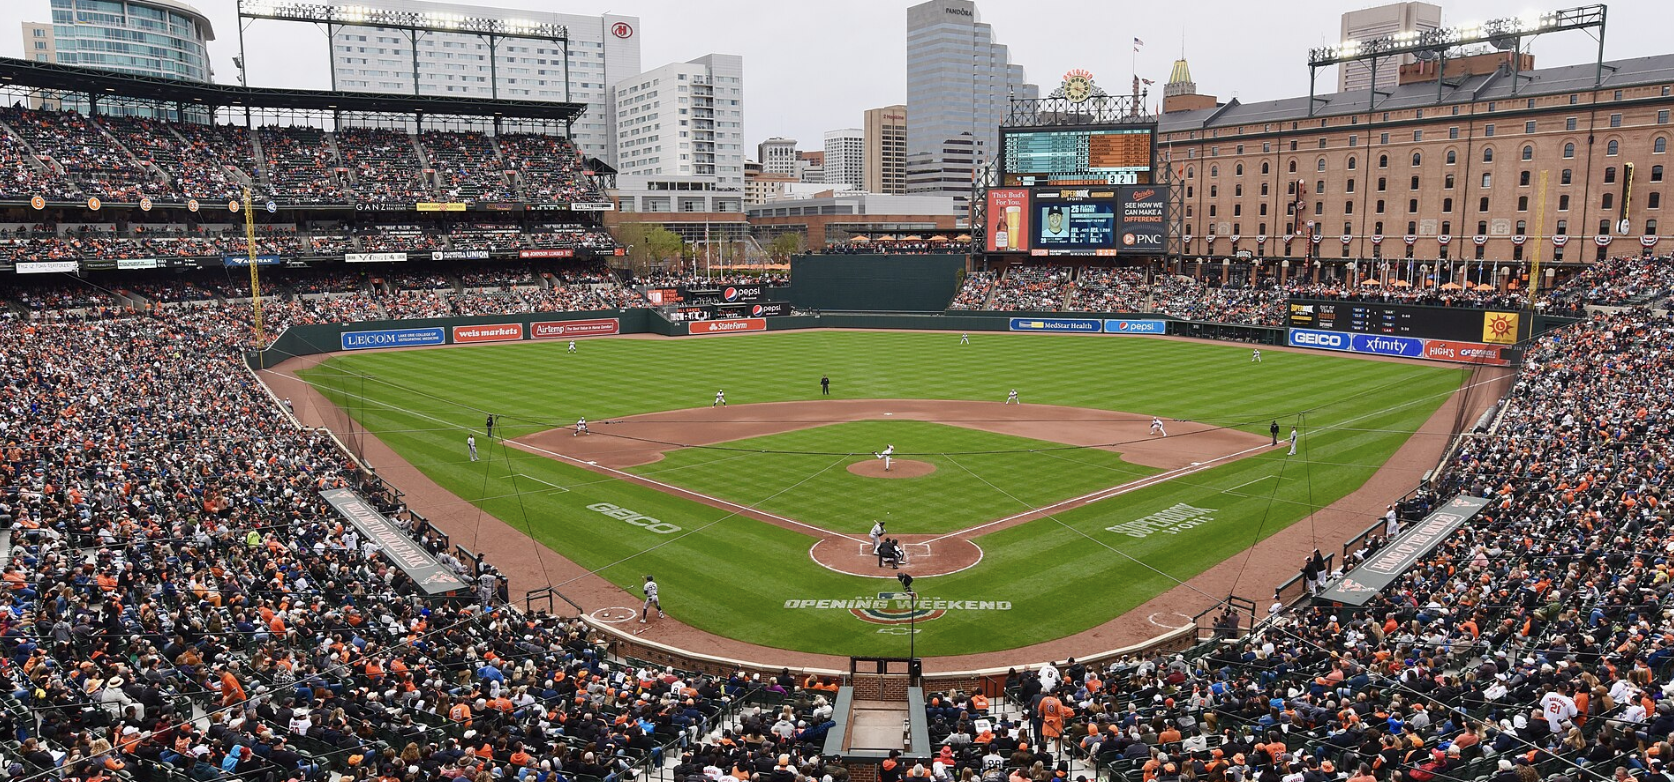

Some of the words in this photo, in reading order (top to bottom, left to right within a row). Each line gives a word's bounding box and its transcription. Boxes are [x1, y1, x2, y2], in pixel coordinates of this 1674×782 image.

[946, 8, 973, 16] PANDORA
[1110, 175, 1115, 184] 3
[1120, 175, 1124, 183] 2
[1136, 234, 1161, 244] PNC
[738, 287, 760, 296] pepsi
[648, 292, 661, 303] $10
[537, 325, 564, 334] Airtemp
[1130, 323, 1154, 331] pepsi
[459, 329, 480, 337] weis
[481, 328, 518, 336] markets
[1295, 333, 1341, 346] GEICO
[1366, 338, 1407, 354] xfinity
[1430, 347, 1454, 357] HIGH'S
[586, 503, 682, 534] GEICO
[1419, 515, 1457, 536] ORIOLES
[1404, 534, 1432, 546] THE
[368, 523, 388, 532] TO
[397, 550, 430, 568] PARK
[1395, 544, 1418, 553] OF
[1371, 552, 1410, 571] HOME
[784, 599, 888, 609] OPENING
[896, 600, 1012, 610] WEEKEND
[1047, 704, 1055, 713] 10
[1550, 703, 1560, 714] 21
